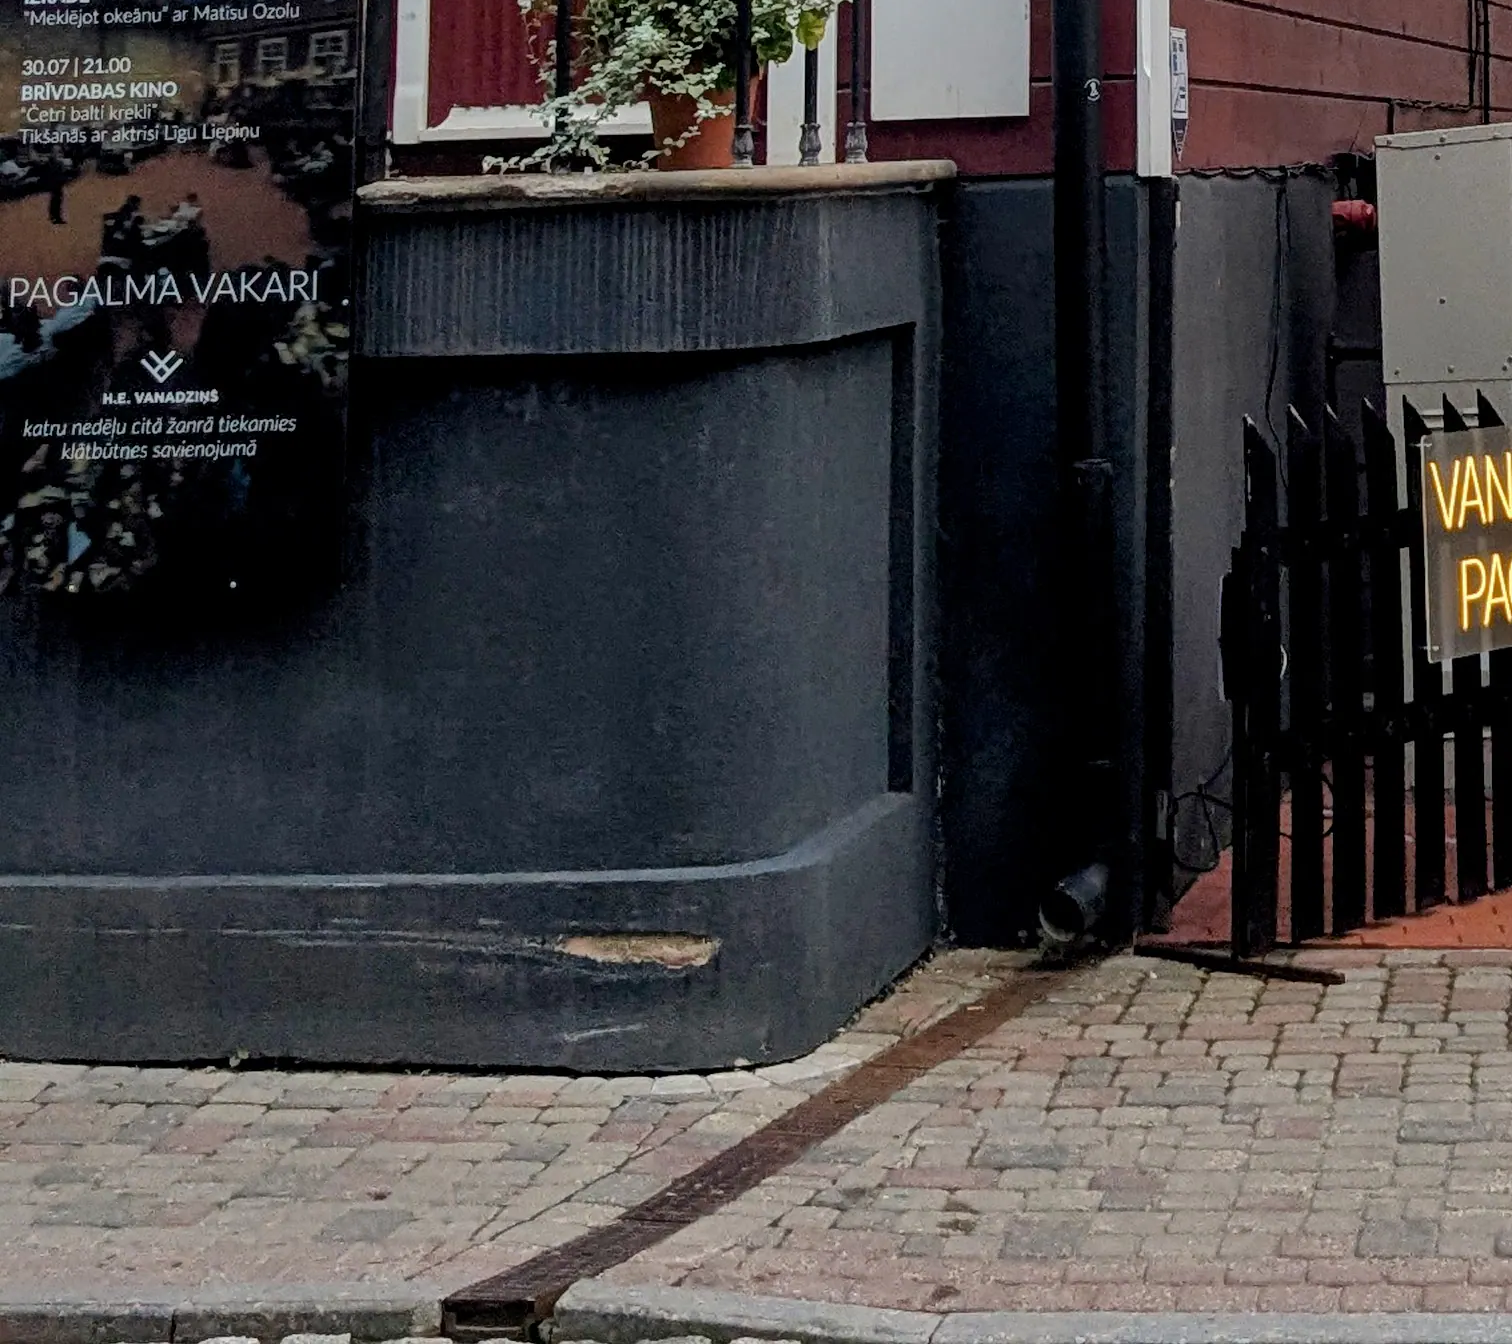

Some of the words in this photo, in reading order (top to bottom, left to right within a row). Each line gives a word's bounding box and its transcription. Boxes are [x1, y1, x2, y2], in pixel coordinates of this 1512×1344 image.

[172, 9, 189, 23] ar
[193, 4, 248, 21] Matīsu
[252, 1, 300, 20] Ozolu
[22, 58, 69, 76] 30.07
[83, 56, 132, 75] 21.00
[20, 82, 126, 102] BRĪVDABAS
[129, 81, 178, 98] KINO
[71, 103, 104, 121] balti
[18, 127, 87, 144] Tikšanās
[91, 129, 108, 143] ar
[112, 123, 160, 142] aktrisi
[164, 123, 197, 144] Līgu
[202, 122, 261, 143] Liepiņu
[9, 273, 183, 308] PAGALMA
[190, 270, 319, 304] VAKARI
[102, 392, 131, 405] H.E.
[134, 389, 220, 405] VANADZIŅŠ
[23, 419, 67, 437] katru
[71, 416, 127, 440] nedēļu
[131, 416, 163, 435] citā
[166, 416, 214, 435] žanrā
[219, 413, 297, 433] tiekamies
[60, 441, 148, 461] klātbūtnes
[152, 439, 258, 461] savienojumā
